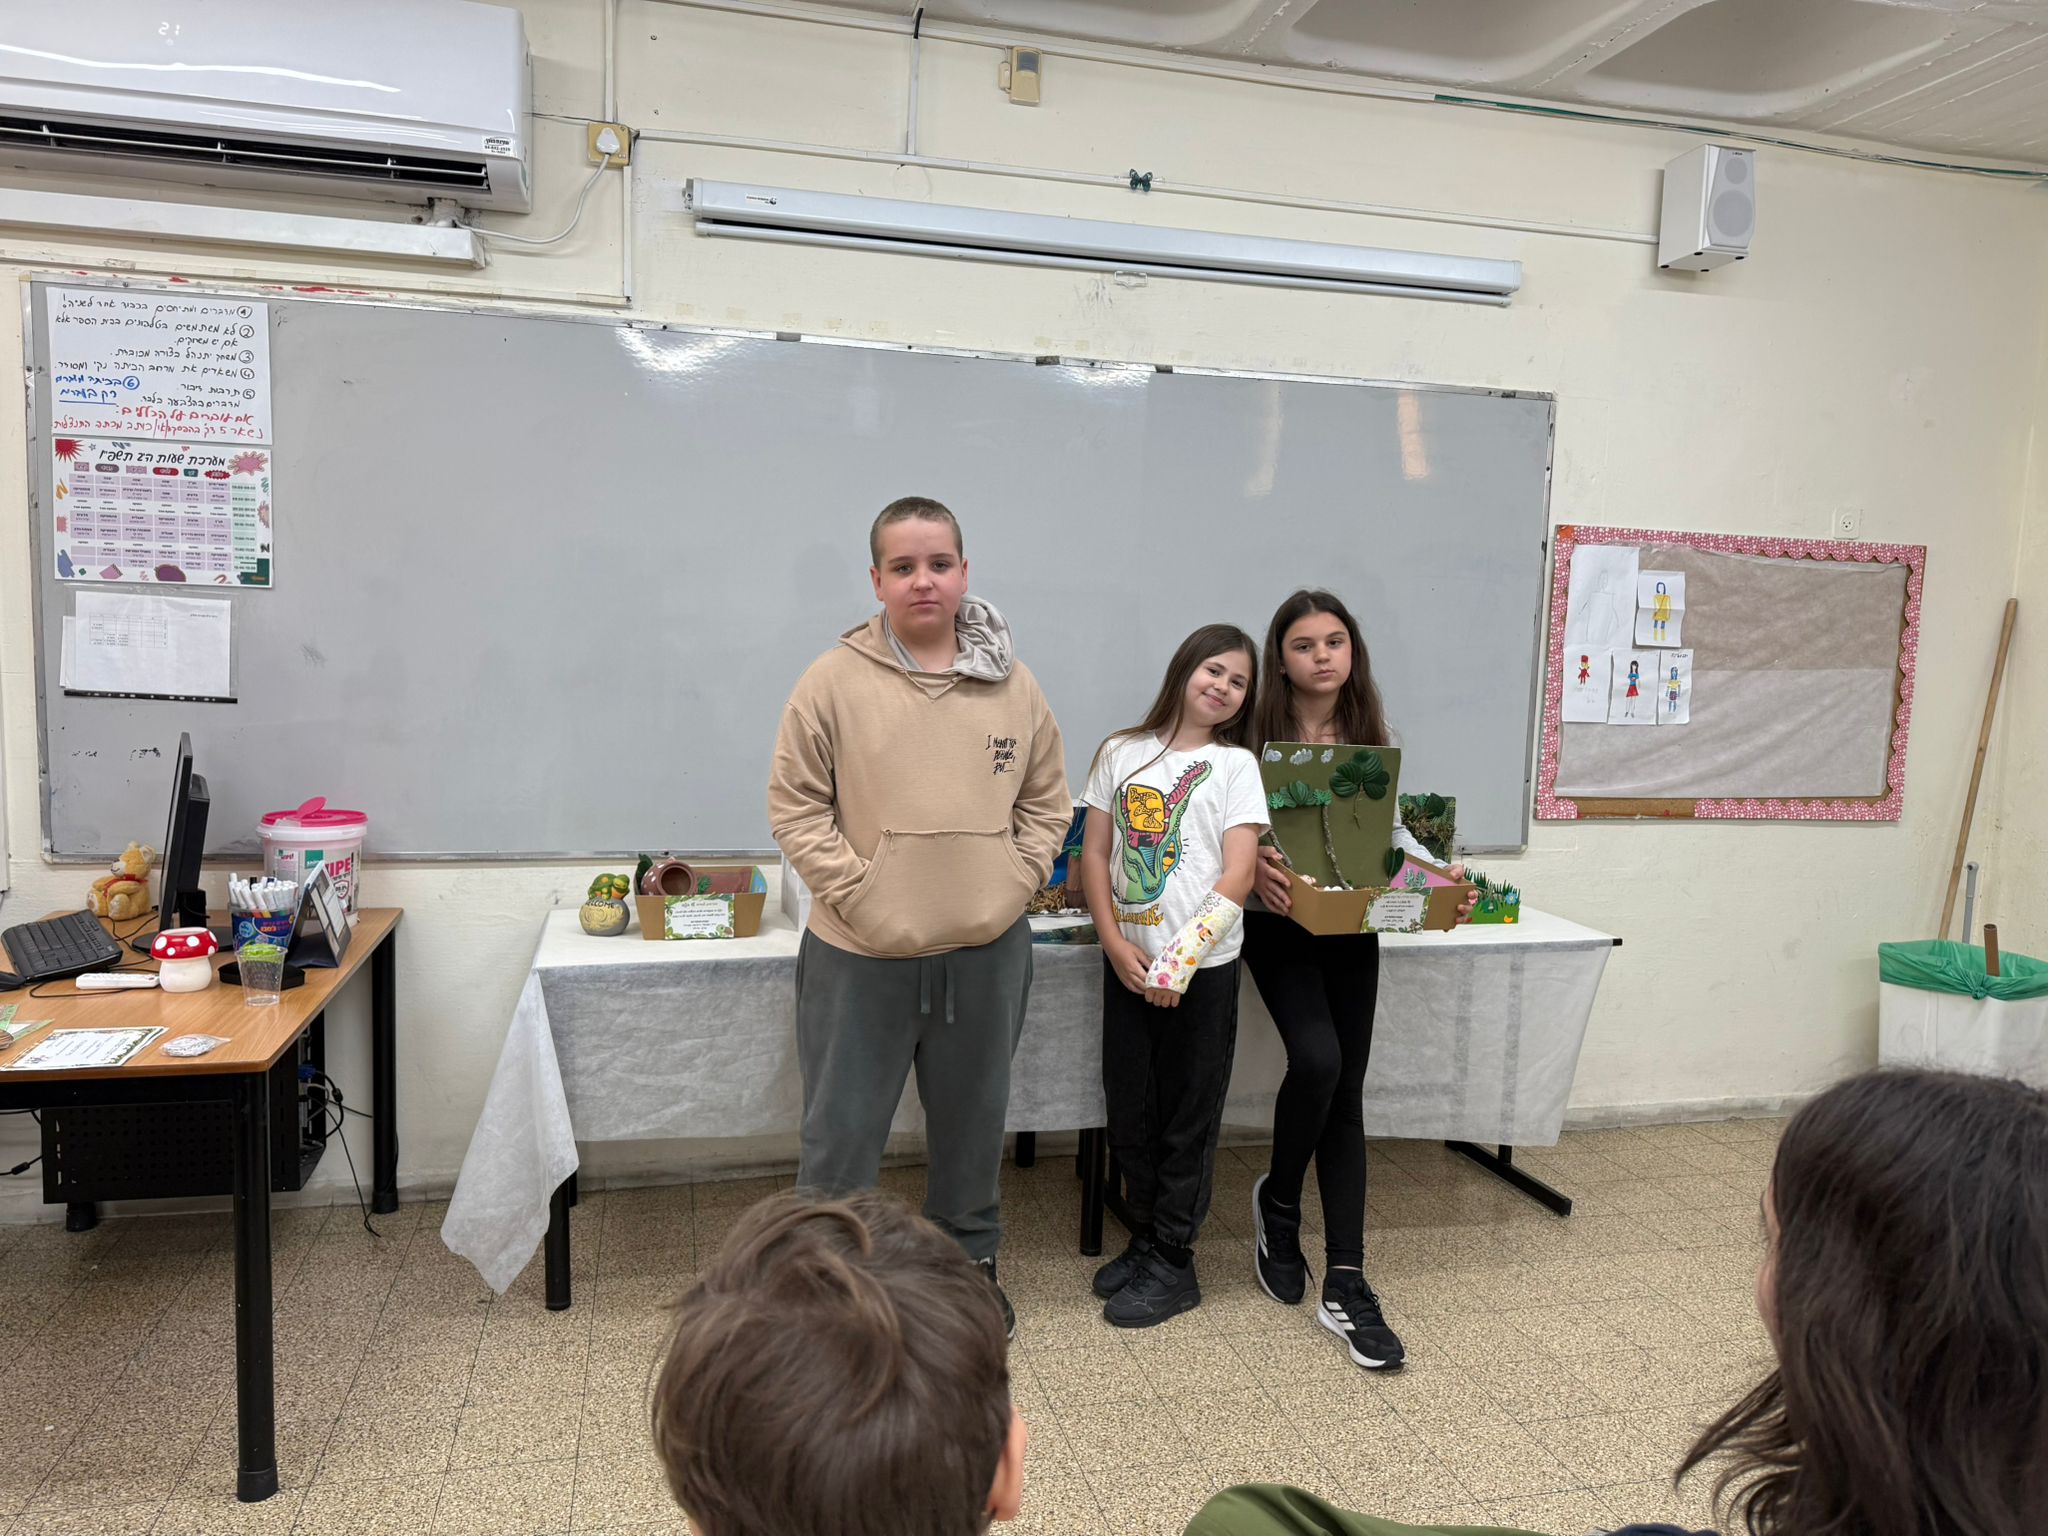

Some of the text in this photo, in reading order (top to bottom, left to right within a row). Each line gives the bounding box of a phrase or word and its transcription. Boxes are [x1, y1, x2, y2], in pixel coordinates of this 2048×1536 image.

[158, 21, 180, 36] 21
[97, 299, 115, 308] אחד
[121, 301, 148, 310] בכבוד
[55, 311, 71, 322] אלא
[200, 307, 236, 316] מדברים
[73, 315, 97, 325] הספר
[100, 317, 121, 325] בבית
[175, 323, 220, 334] משתמשים
[223, 322, 238, 336] לא
[211, 338, 220, 346] יש
[221, 338, 238, 350] אם
[154, 347, 181, 358] בצורה
[185, 347, 212, 359] יתנהל
[215, 352, 237, 362] משחק
[93, 361, 107, 372] נקי
[114, 362, 145, 371] הכיתה
[148, 364, 175, 373] מרחב
[181, 364, 197, 373] את
[101, 389, 117, 403] רק
[208, 387, 241, 397] תרבות
[167, 395, 204, 407] בהצבעה
[206, 400, 241, 408] מדברים
[170, 408, 186, 422] על
[189, 411, 233, 423] עוברים
[235, 413, 254, 426] אם
[229, 426, 264, 439] נשאר
[156, 452, 185, 464] שעות
[187, 455, 226, 466] מערכת
